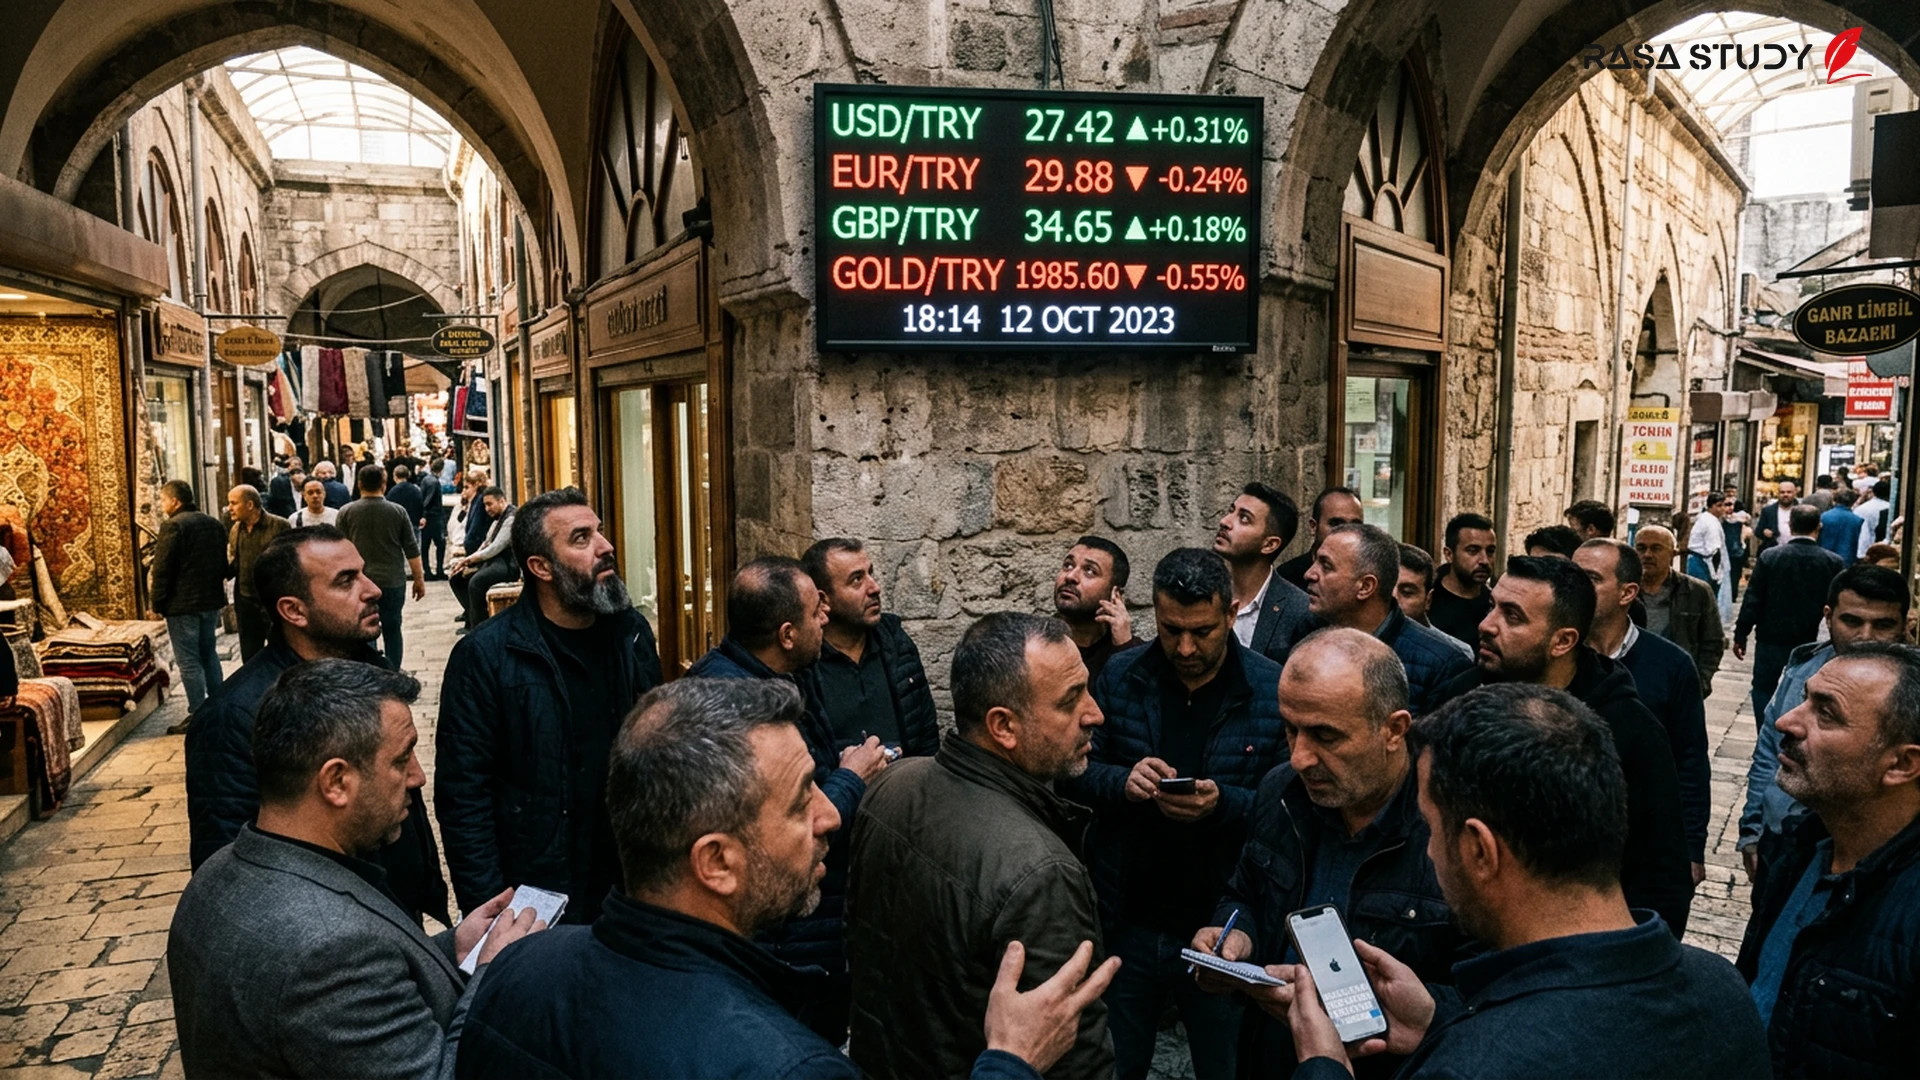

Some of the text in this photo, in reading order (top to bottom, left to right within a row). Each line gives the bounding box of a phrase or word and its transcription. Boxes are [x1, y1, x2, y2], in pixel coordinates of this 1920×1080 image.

[832, 102, 1249, 144] USD/TRY 27.42 +0.31%
[832, 154, 1248, 195] EUR/TRY 29.88 -0.24%
[832, 205, 1247, 246] GBP/TRY 34.65 +0.18%
[832, 255, 1245, 296] GOLD/TRY 1985.60 -0.55%
[903, 303, 1175, 334] 18:14 12 OCT 2023
